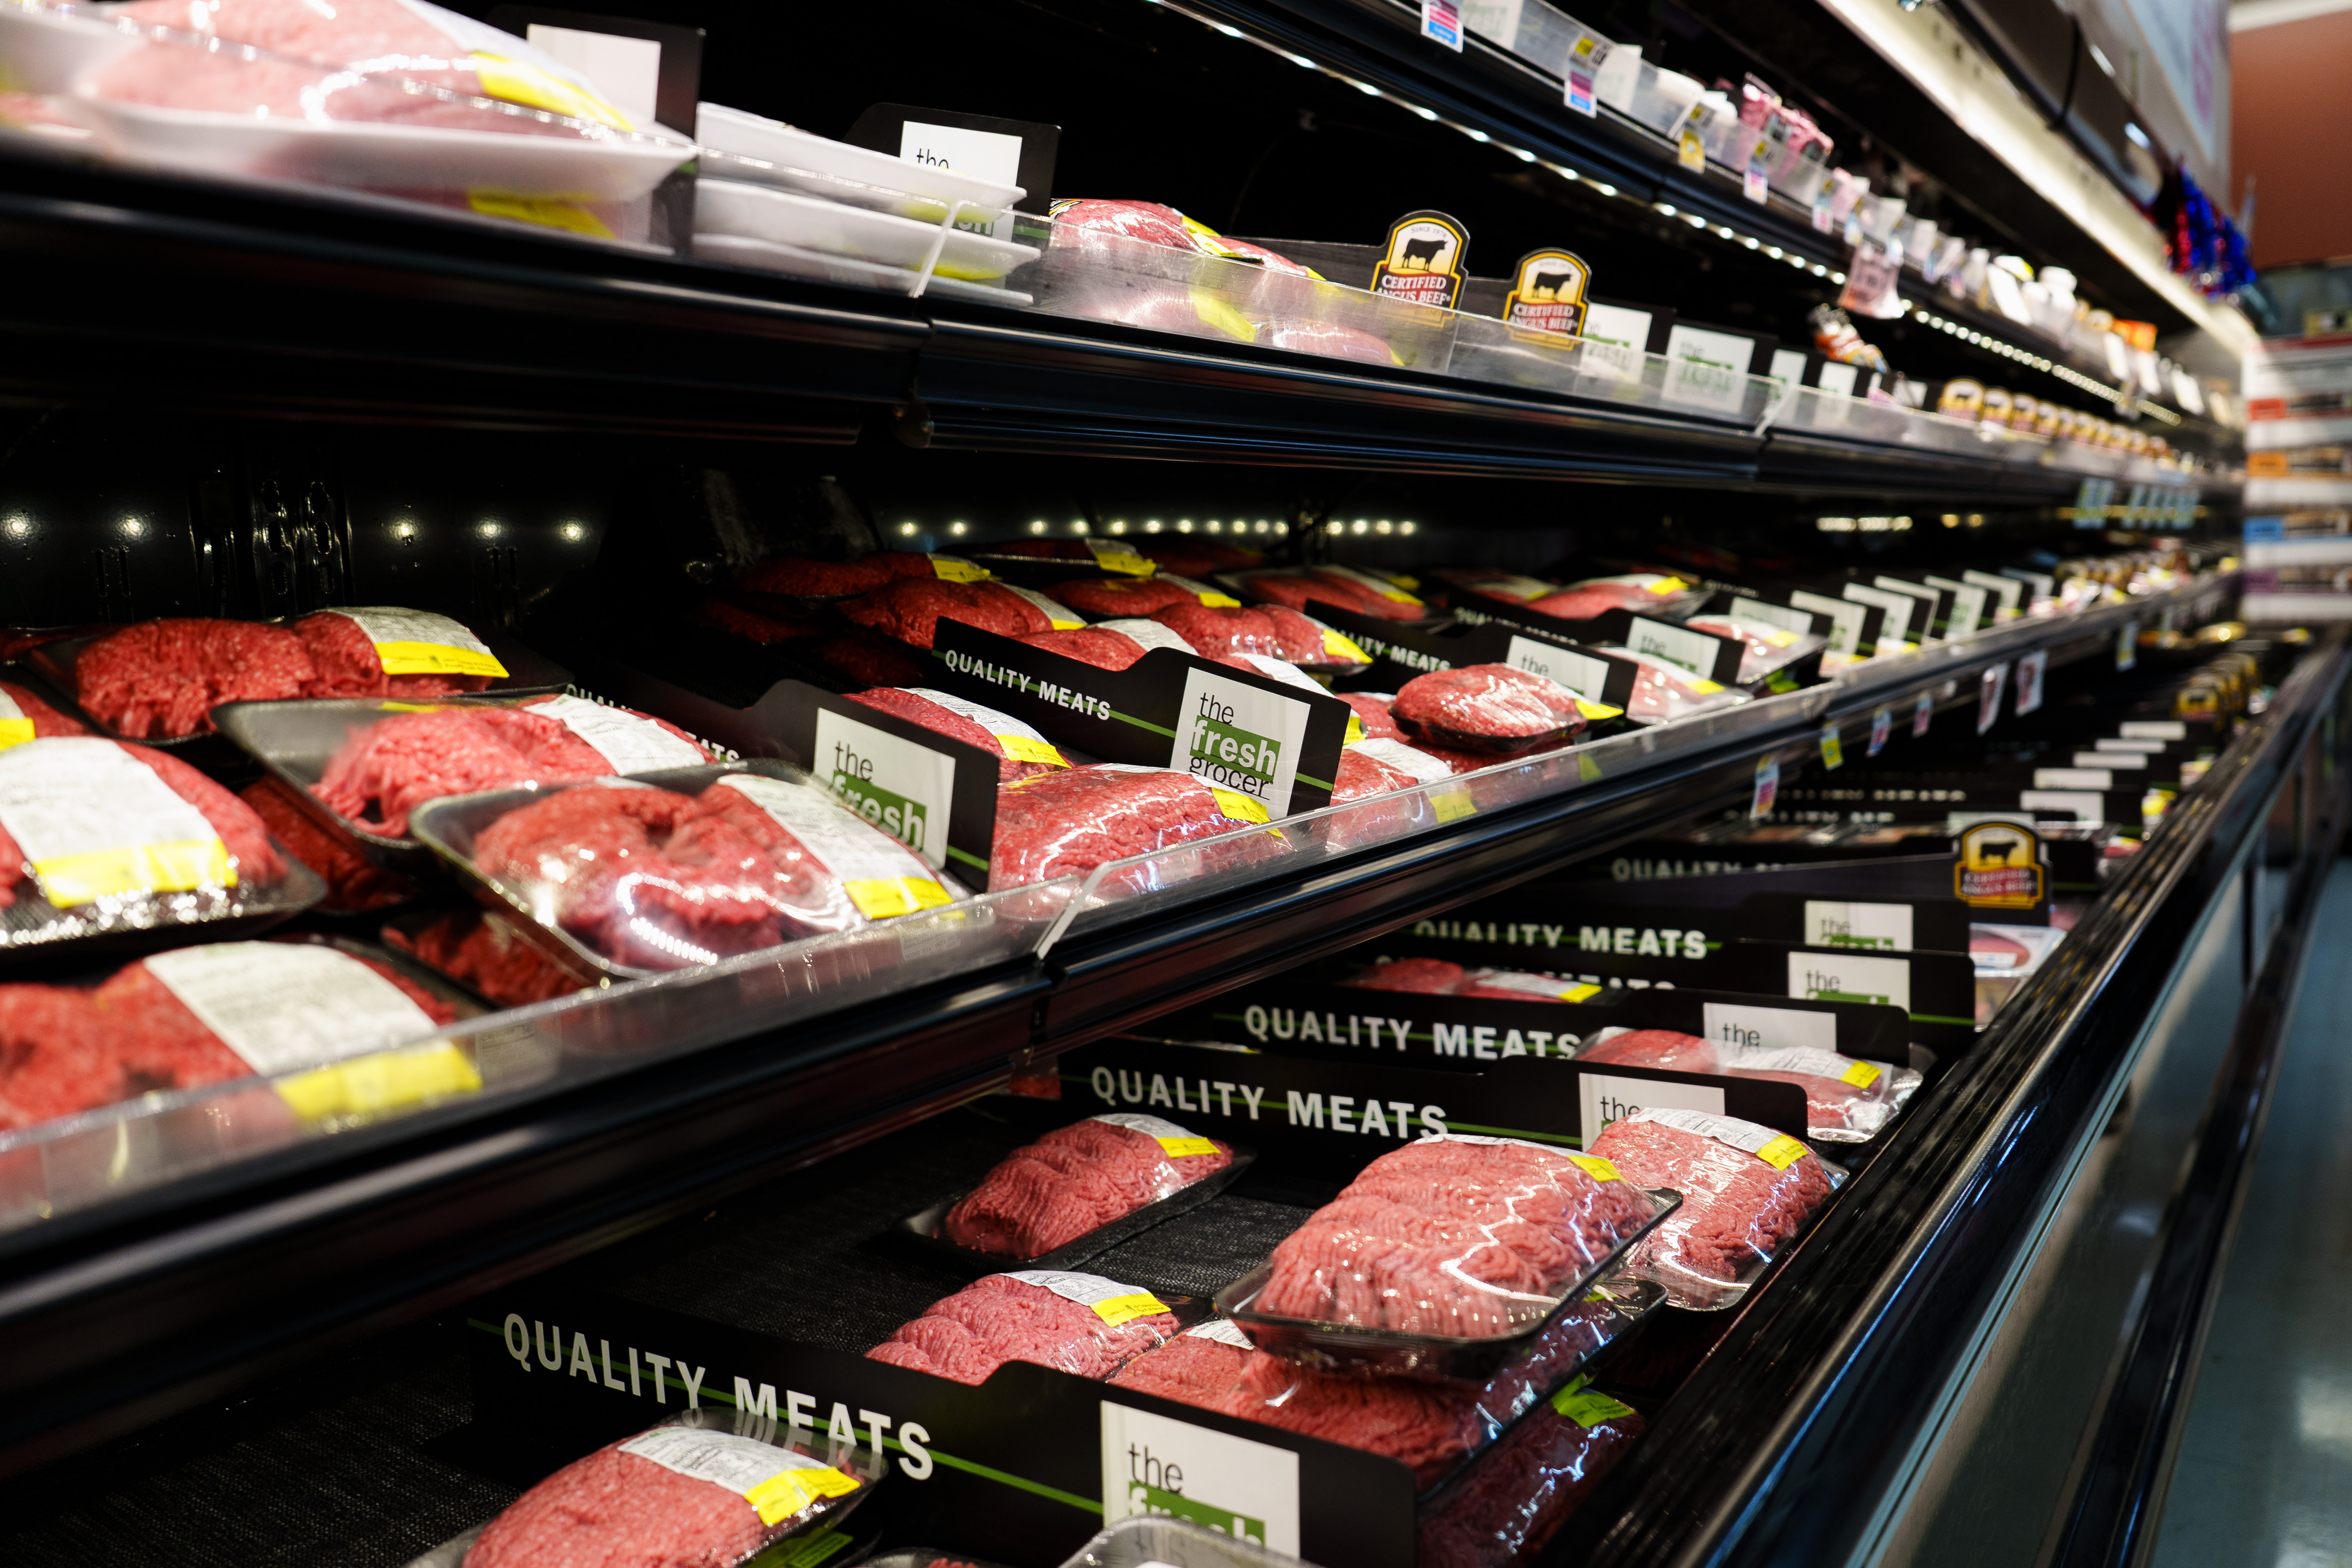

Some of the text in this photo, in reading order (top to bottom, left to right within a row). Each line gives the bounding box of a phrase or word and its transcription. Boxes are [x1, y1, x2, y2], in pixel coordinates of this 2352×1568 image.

[1382, 274, 1447, 290] CERTIFIED
[1513, 302, 1574, 317] CERTIFIED
[946, 648, 1111, 720] QUALITY MEATS
[1200, 692, 1234, 726] the
[835, 740, 874, 782] the
[1191, 719, 1276, 776] fresh
[1579, 926, 1707, 960] MEATS
[1244, 1004, 1582, 1060] QUALITY MEATS
[1723, 1022, 1761, 1047] the
[1091, 1066, 1449, 1139] QUALITY MEATS
[504, 1313, 934, 1480] QUALITY MEATS
[1128, 1442, 1184, 1497] the
